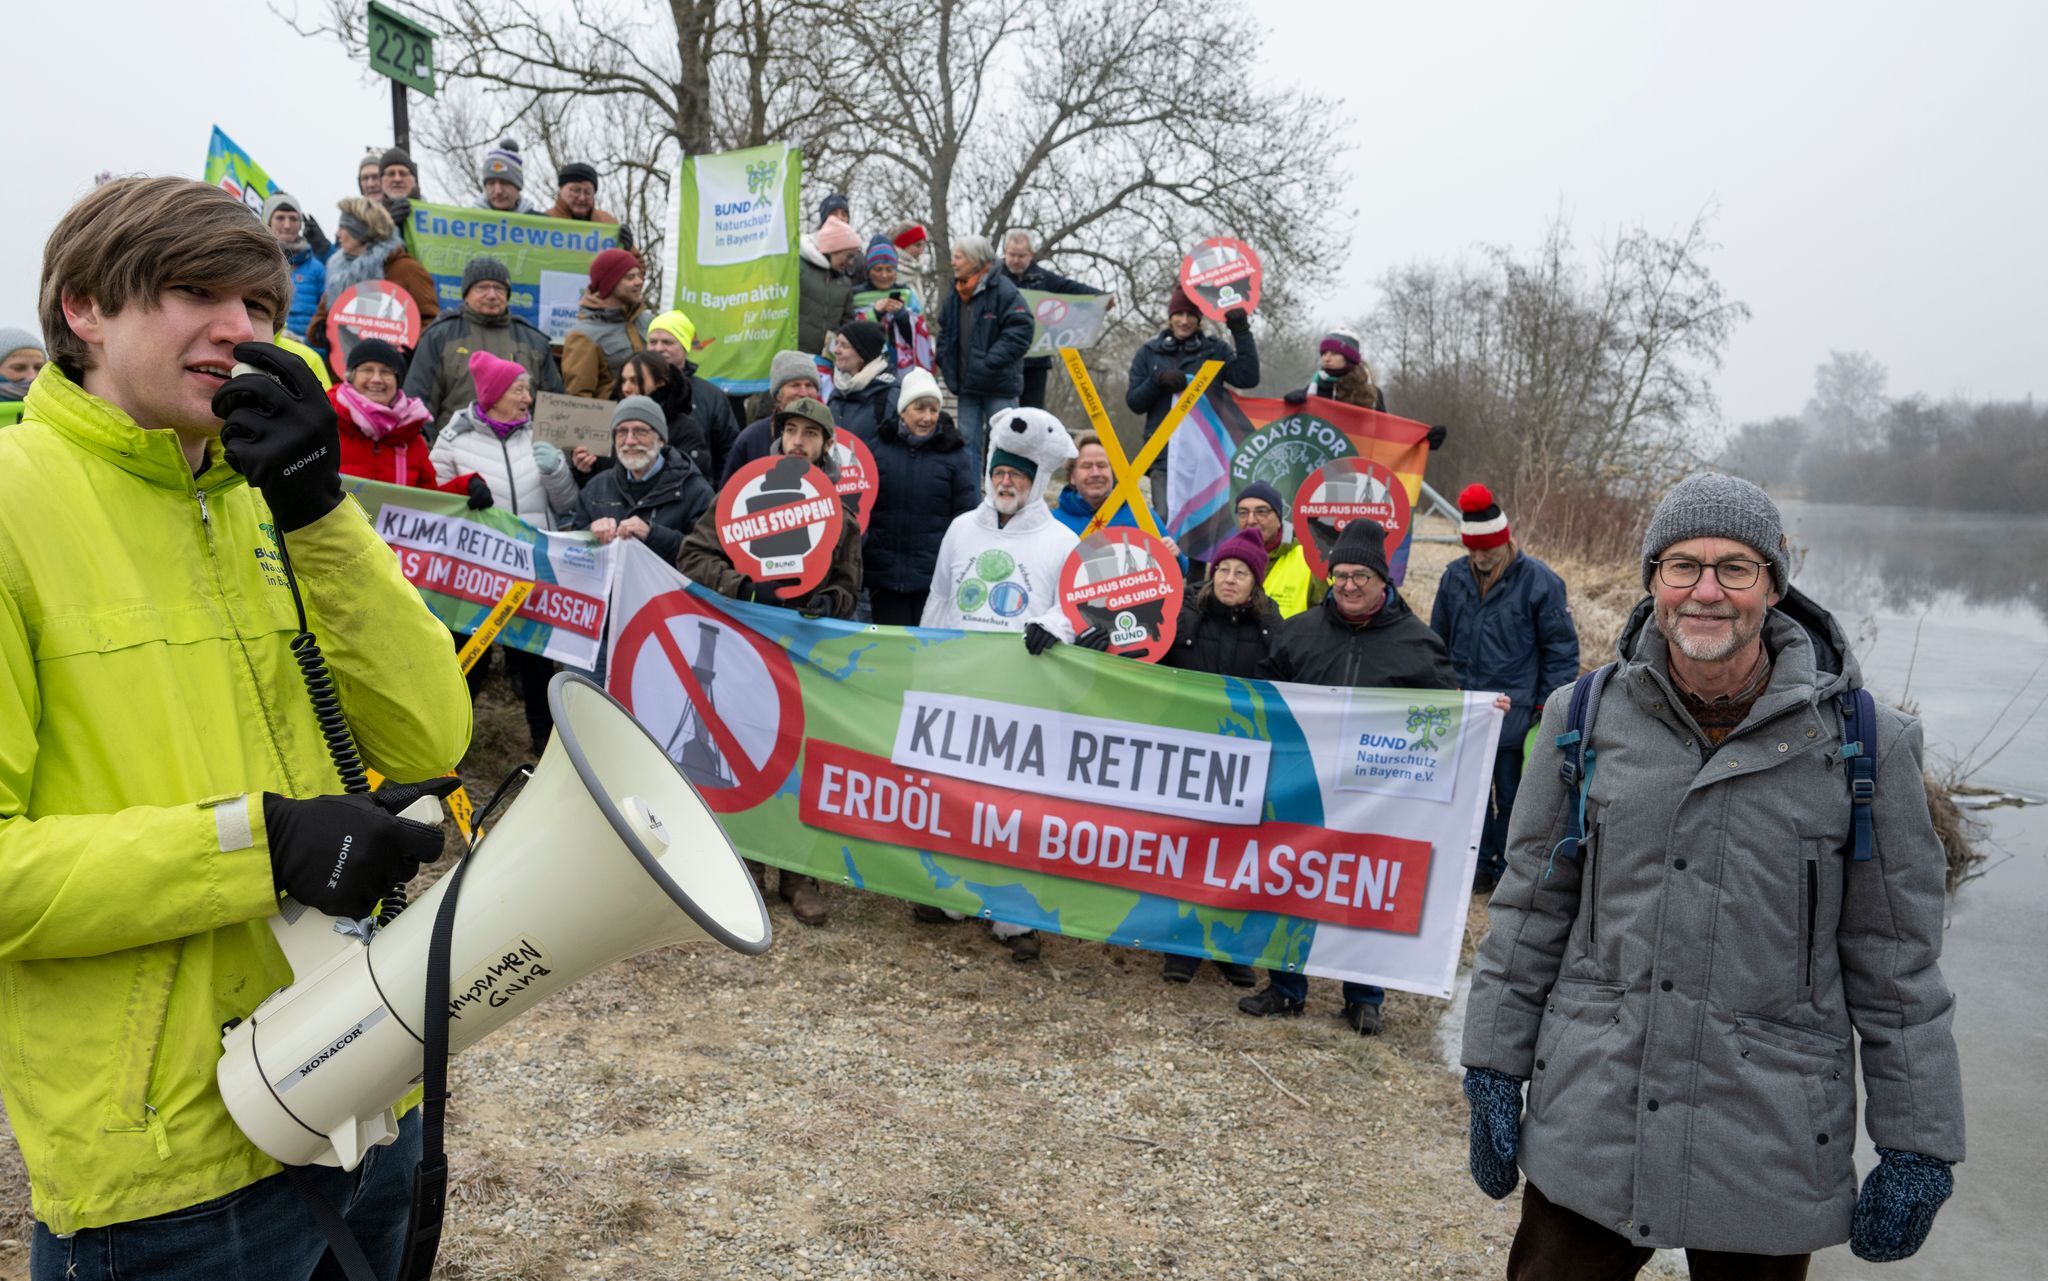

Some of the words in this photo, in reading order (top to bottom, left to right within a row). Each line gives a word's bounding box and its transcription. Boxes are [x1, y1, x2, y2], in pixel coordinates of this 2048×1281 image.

[715, 201, 752, 217] BUND
[414, 209, 618, 251] Energiewende
[715, 213, 772, 232] Naturschutz
[715, 234, 725, 247] in
[726, 231, 758, 247] Bayern
[681, 285, 696, 304] In
[700, 291, 749, 312] Bayern
[751, 281, 790, 303] aktiv
[742, 310, 758, 327] für
[743, 327, 777, 343] Natur
[1233, 417, 1302, 480] FRIDAYS
[1307, 420, 1348, 458] FOR
[283, 452, 321, 477] SIMOND
[722, 516, 769, 545] KOHLE
[769, 497, 836, 532] STOPPEN!
[1300, 505, 1329, 515] RAUS
[1329, 505, 1351, 515] AUS
[1352, 505, 1389, 516] KOHLE,
[1385, 519, 1400, 530] ÖL
[382, 511, 448, 546] KLIMA
[457, 526, 530, 571] RETTEN!
[774, 560, 796, 569] BUND
[426, 556, 453, 586] IM
[523, 589, 598, 631] LASSEN!
[1066, 587, 1096, 602] RAUS
[1097, 581, 1119, 595] AUS
[1119, 571, 1159, 588] KOHLE,
[1109, 594, 1132, 608] GAS
[1132, 588, 1158, 601] UND
[1158, 582, 1174, 595] ÖL
[1114, 630, 1144, 642] BUND
[461, 646, 481, 670] SONN
[1359, 734, 1407, 751] BUND
[910, 705, 1046, 777] KLIMA
[1067, 730, 1251, 809] RETTEN!
[1356, 750, 1437, 769] Naturschutz
[1354, 765, 1367, 777] in
[1369, 767, 1412, 780] Bayern
[1414, 770, 1435, 782] e.V.
[818, 763, 951, 839] ERDÖL
[970, 802, 1022, 853] IM
[1038, 815, 1189, 880] BODEN
[1202, 837, 1402, 912] LASSEN!
[331, 834, 353, 880] SIMOND
[449, 939, 542, 1020] Naturschut
[488, 963, 552, 1008] BUND
